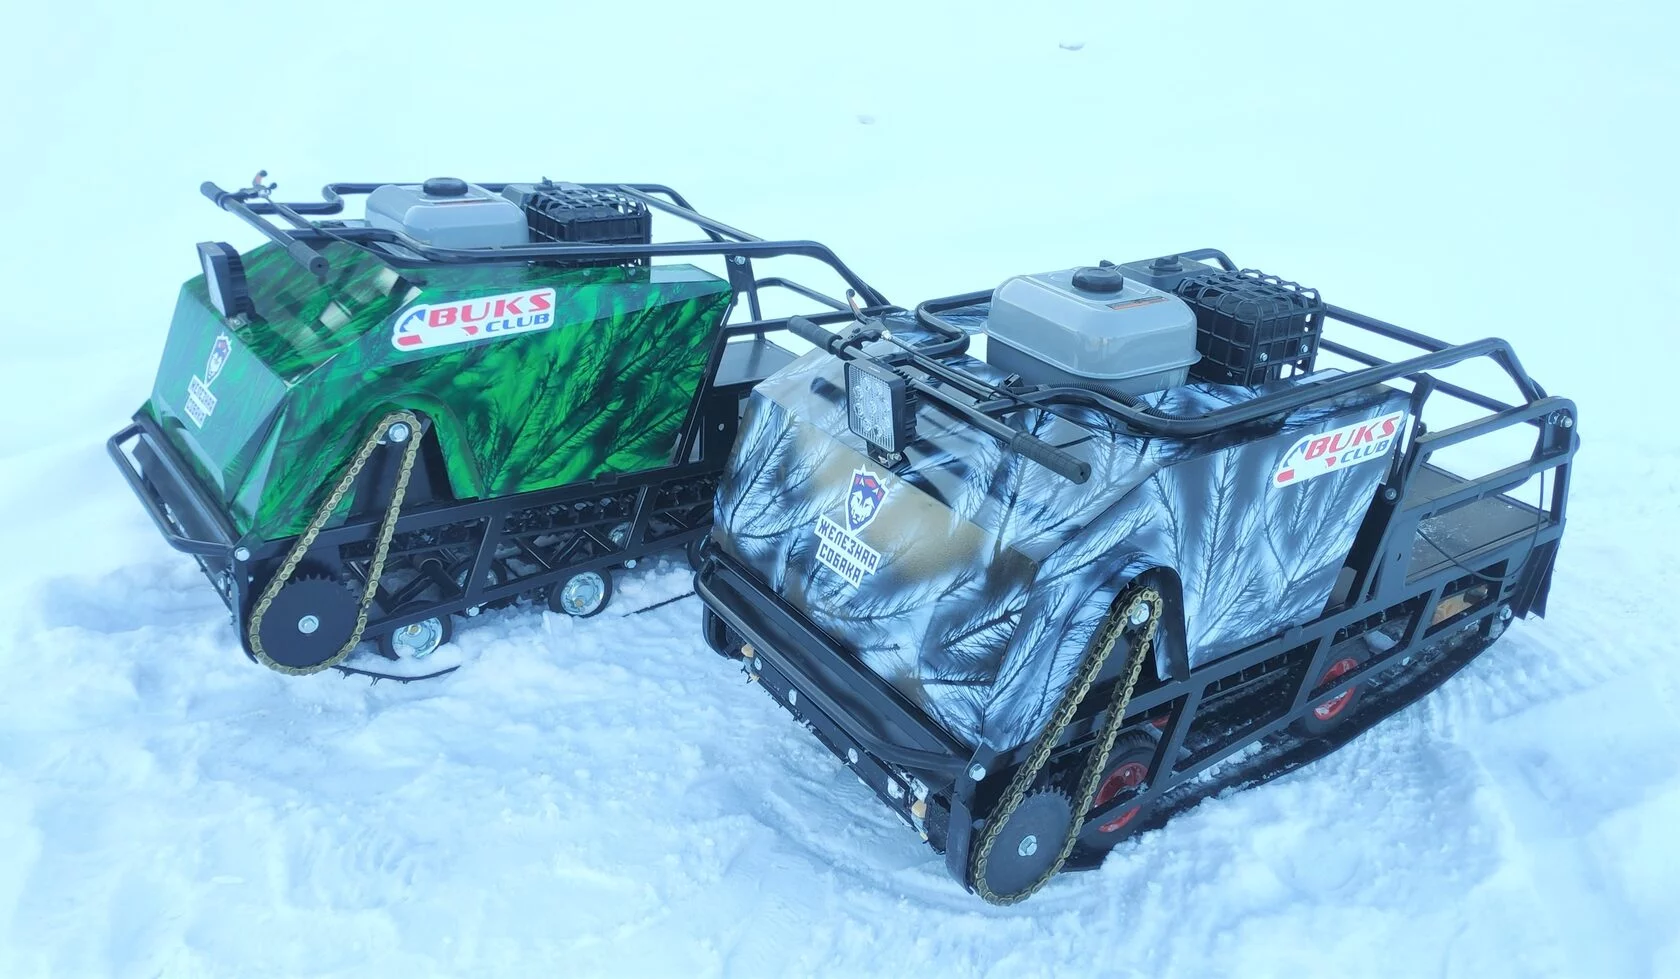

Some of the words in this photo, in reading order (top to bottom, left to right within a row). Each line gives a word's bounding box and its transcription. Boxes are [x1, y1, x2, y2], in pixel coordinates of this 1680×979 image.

[428, 293, 551, 328] BUKS
[485, 313, 550, 333] CLUB
[1304, 416, 1400, 461] BUKS
[1340, 439, 1390, 463] CLUB
[818, 518, 878, 571] ЖЕЛЕЗНАЯ
[819, 543, 862, 584] СОБАКА
